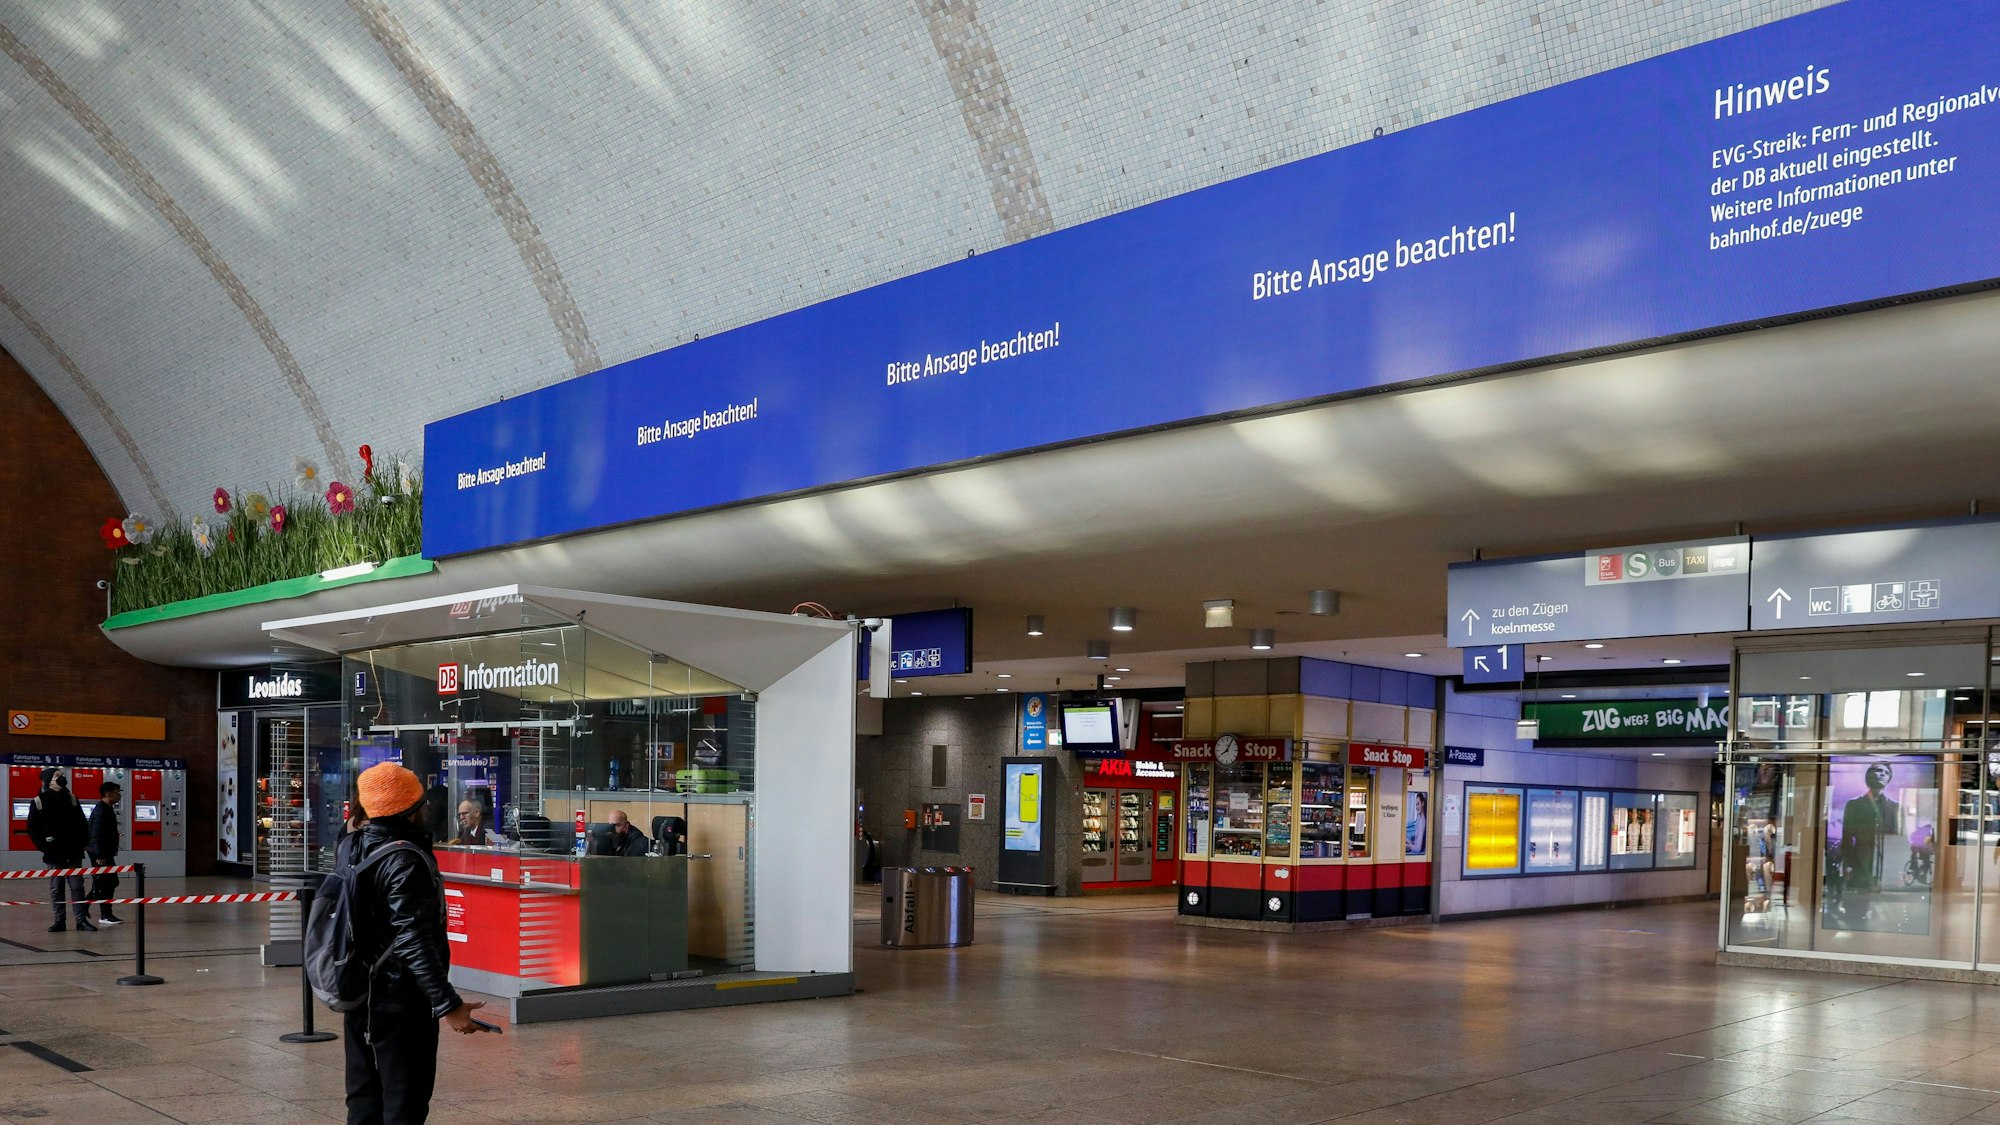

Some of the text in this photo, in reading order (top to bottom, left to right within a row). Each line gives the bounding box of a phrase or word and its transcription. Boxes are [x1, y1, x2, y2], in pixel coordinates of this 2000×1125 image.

[1713, 65, 1831, 120] Hinweis
[1712, 85, 2000, 169] EVG-Streik: Fern- und Regionalv
[1710, 130, 1939, 196] der DB aktuell eingestellt.
[1710, 154, 1958, 223] Weitere Informationen unter
[1709, 205, 1864, 250] bahnhof.de/zuege
[1252, 211, 1516, 300] Bitte Ansage beachten!
[886, 321, 1061, 386] Bitte Ansage beachten!
[636, 397, 758, 445] Bitte Ansage beachten!
[457, 452, 546, 490] Bitte Ansage beachten!
[1628, 553, 1648, 577] S
[1658, 558, 1676, 567] Bus
[1685, 556, 1705, 565] TAXI
[1492, 601, 1568, 618] zu den Zügen
[1811, 600, 1832, 612] WC
[1491, 619, 1555, 634] koelnmesse
[1497, 645, 1508, 671] 1
[249, 673, 302, 698] Leonidas
[440, 658, 559, 690] DB Information
[1582, 708, 1620, 732] ZUG
[1622, 714, 1649, 727] WEG?
[1174, 743, 1212, 757] Snack
[1244, 742, 1277, 759] Stop
[1363, 748, 1412, 766] Snack Stop
[1448, 748, 1477, 762] A-Passage
[1135, 762, 1158, 770] Mobile
[1158, 762, 1164, 770] &
[1135, 769, 1175, 778] Accessoires
[905, 890, 915, 935] Abfall
